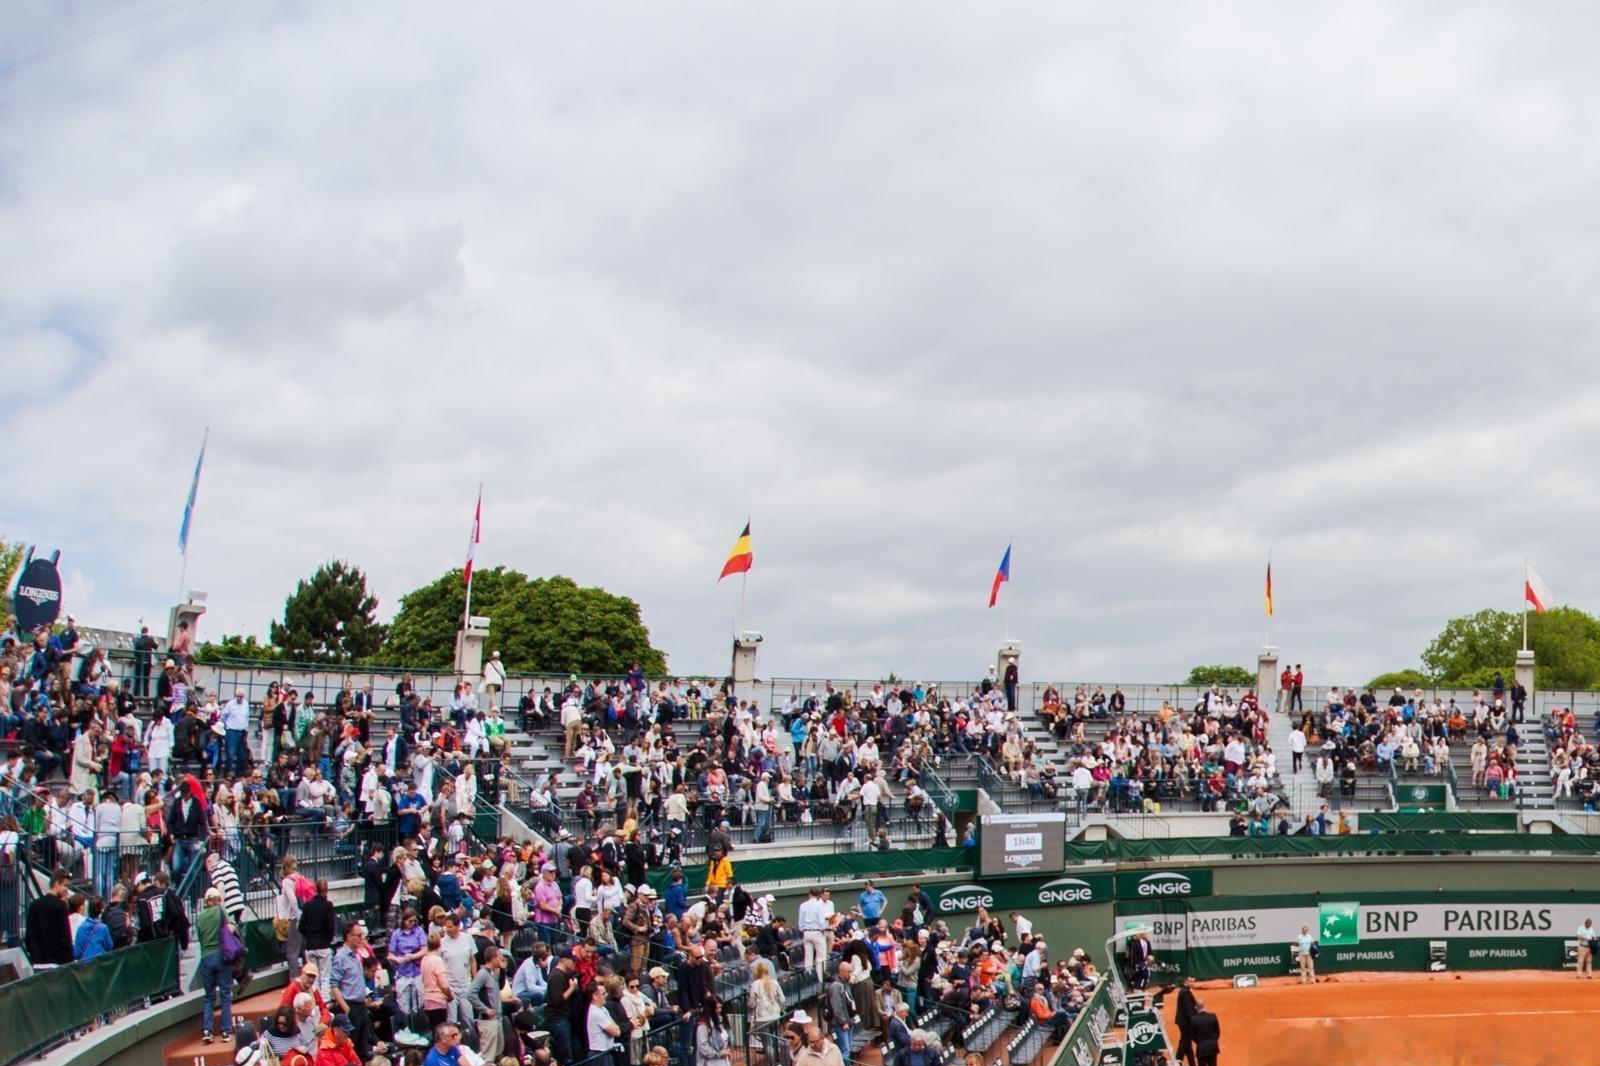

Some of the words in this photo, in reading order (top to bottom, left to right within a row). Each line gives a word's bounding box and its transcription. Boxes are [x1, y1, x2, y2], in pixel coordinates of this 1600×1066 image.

[1013, 836, 1036, 847] 1h40
[1153, 921, 1184, 936] BNP
[1191, 916, 1257, 933] PARIBAS
[1366, 910, 1419, 933] BNP
[1443, 909, 1552, 932] PARIBAS
[1336, 952, 1355, 961] BNP
[1356, 951, 1394, 960] PARIBAS
[1469, 949, 1487, 958] BNP
[1489, 949, 1527, 958] PARIBAS
[1223, 957, 1242, 967] BNP
[1244, 955, 1281, 966] PARIBAS
